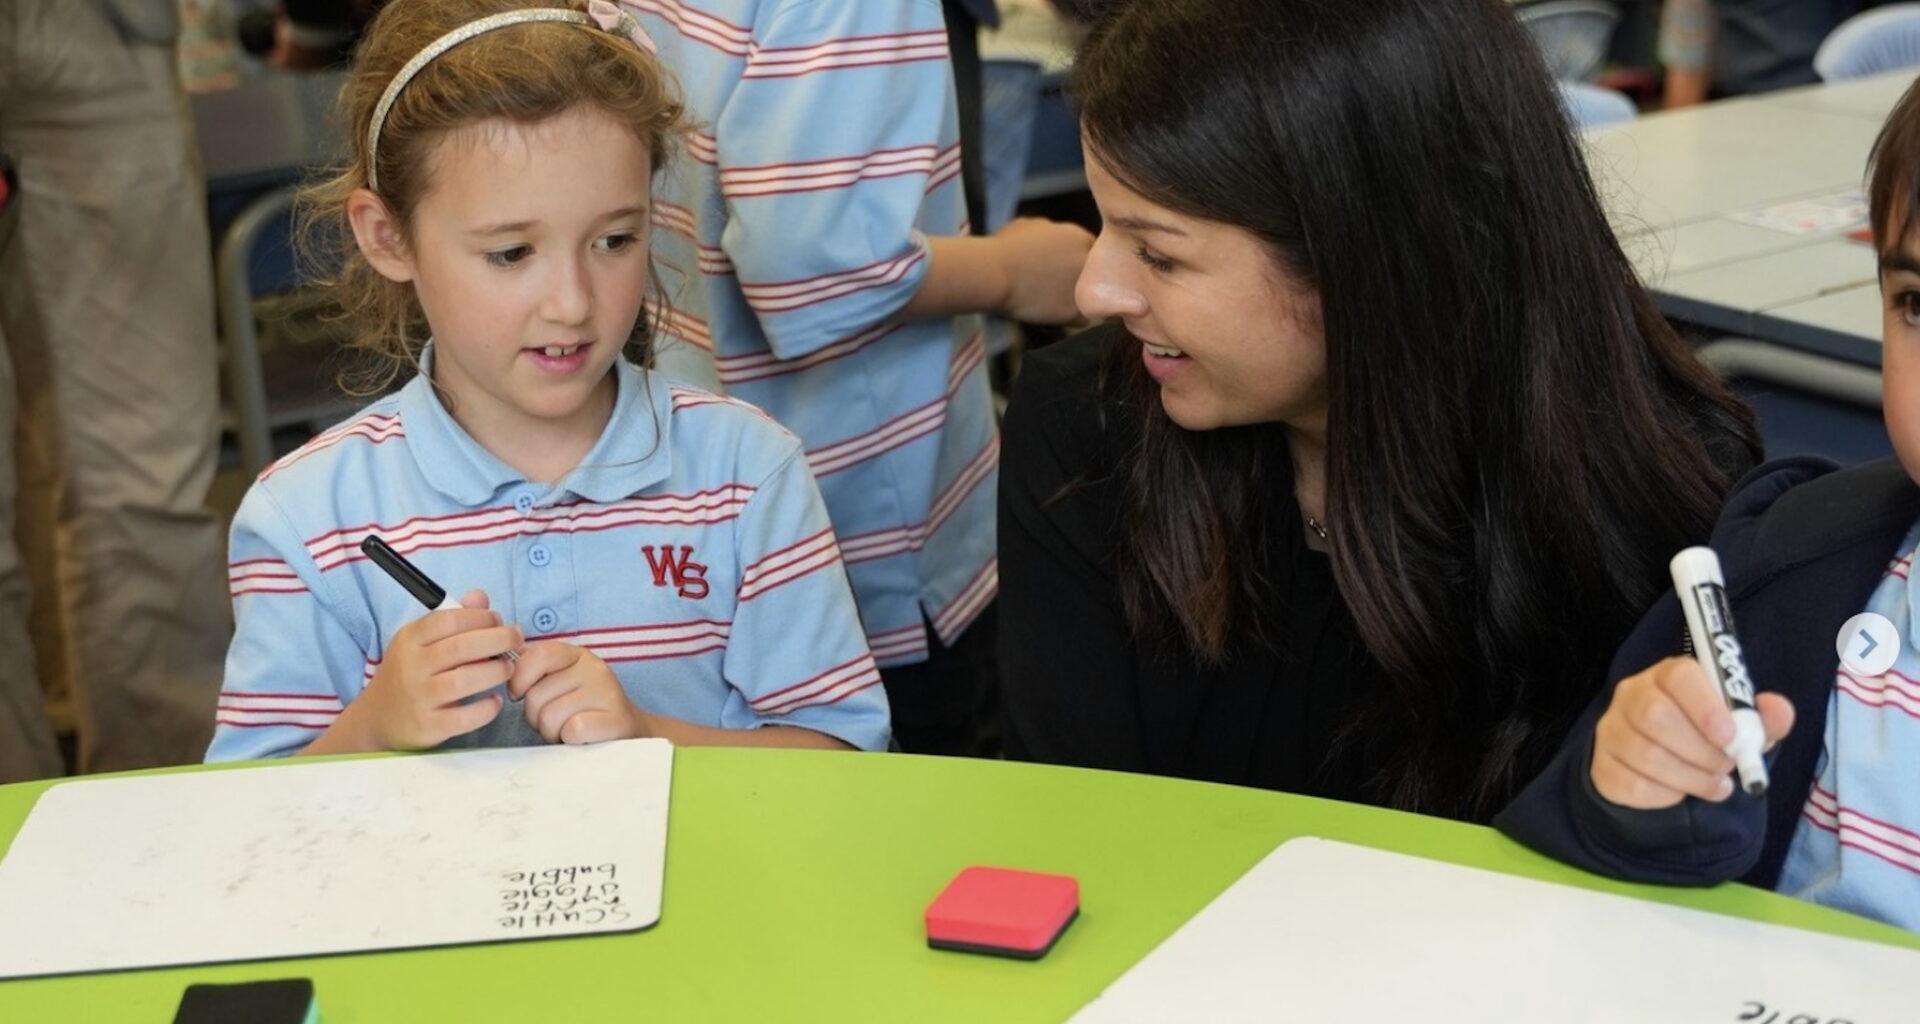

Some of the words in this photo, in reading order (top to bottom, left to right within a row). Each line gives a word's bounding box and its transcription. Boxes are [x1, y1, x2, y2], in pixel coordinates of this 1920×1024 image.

[641, 544, 710, 601] WS
[1713, 634, 1755, 706] EXPO
[501, 862, 616, 886] bubble
